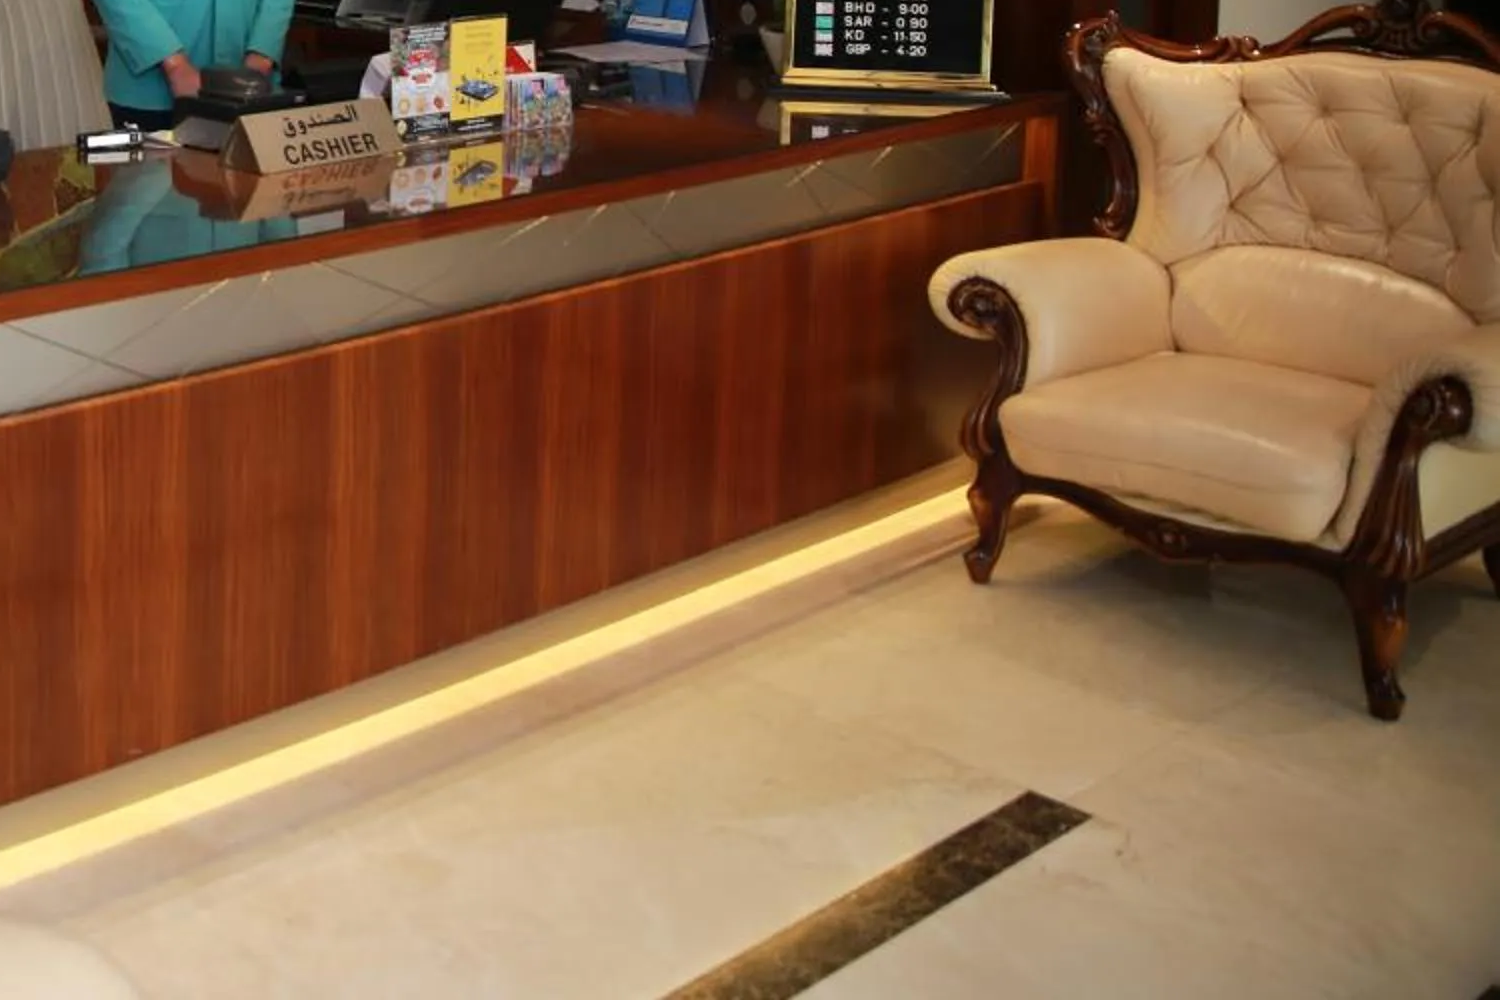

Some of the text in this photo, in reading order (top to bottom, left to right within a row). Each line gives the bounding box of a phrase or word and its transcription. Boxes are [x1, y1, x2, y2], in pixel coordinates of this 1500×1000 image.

[845, 1, 876, 13] BHD
[844, 15, 873, 27] SAR
[845, 29, 865, 41] KD
[283, 104, 359, 138] الصندوق
[283, 132, 379, 165] CASHIER
